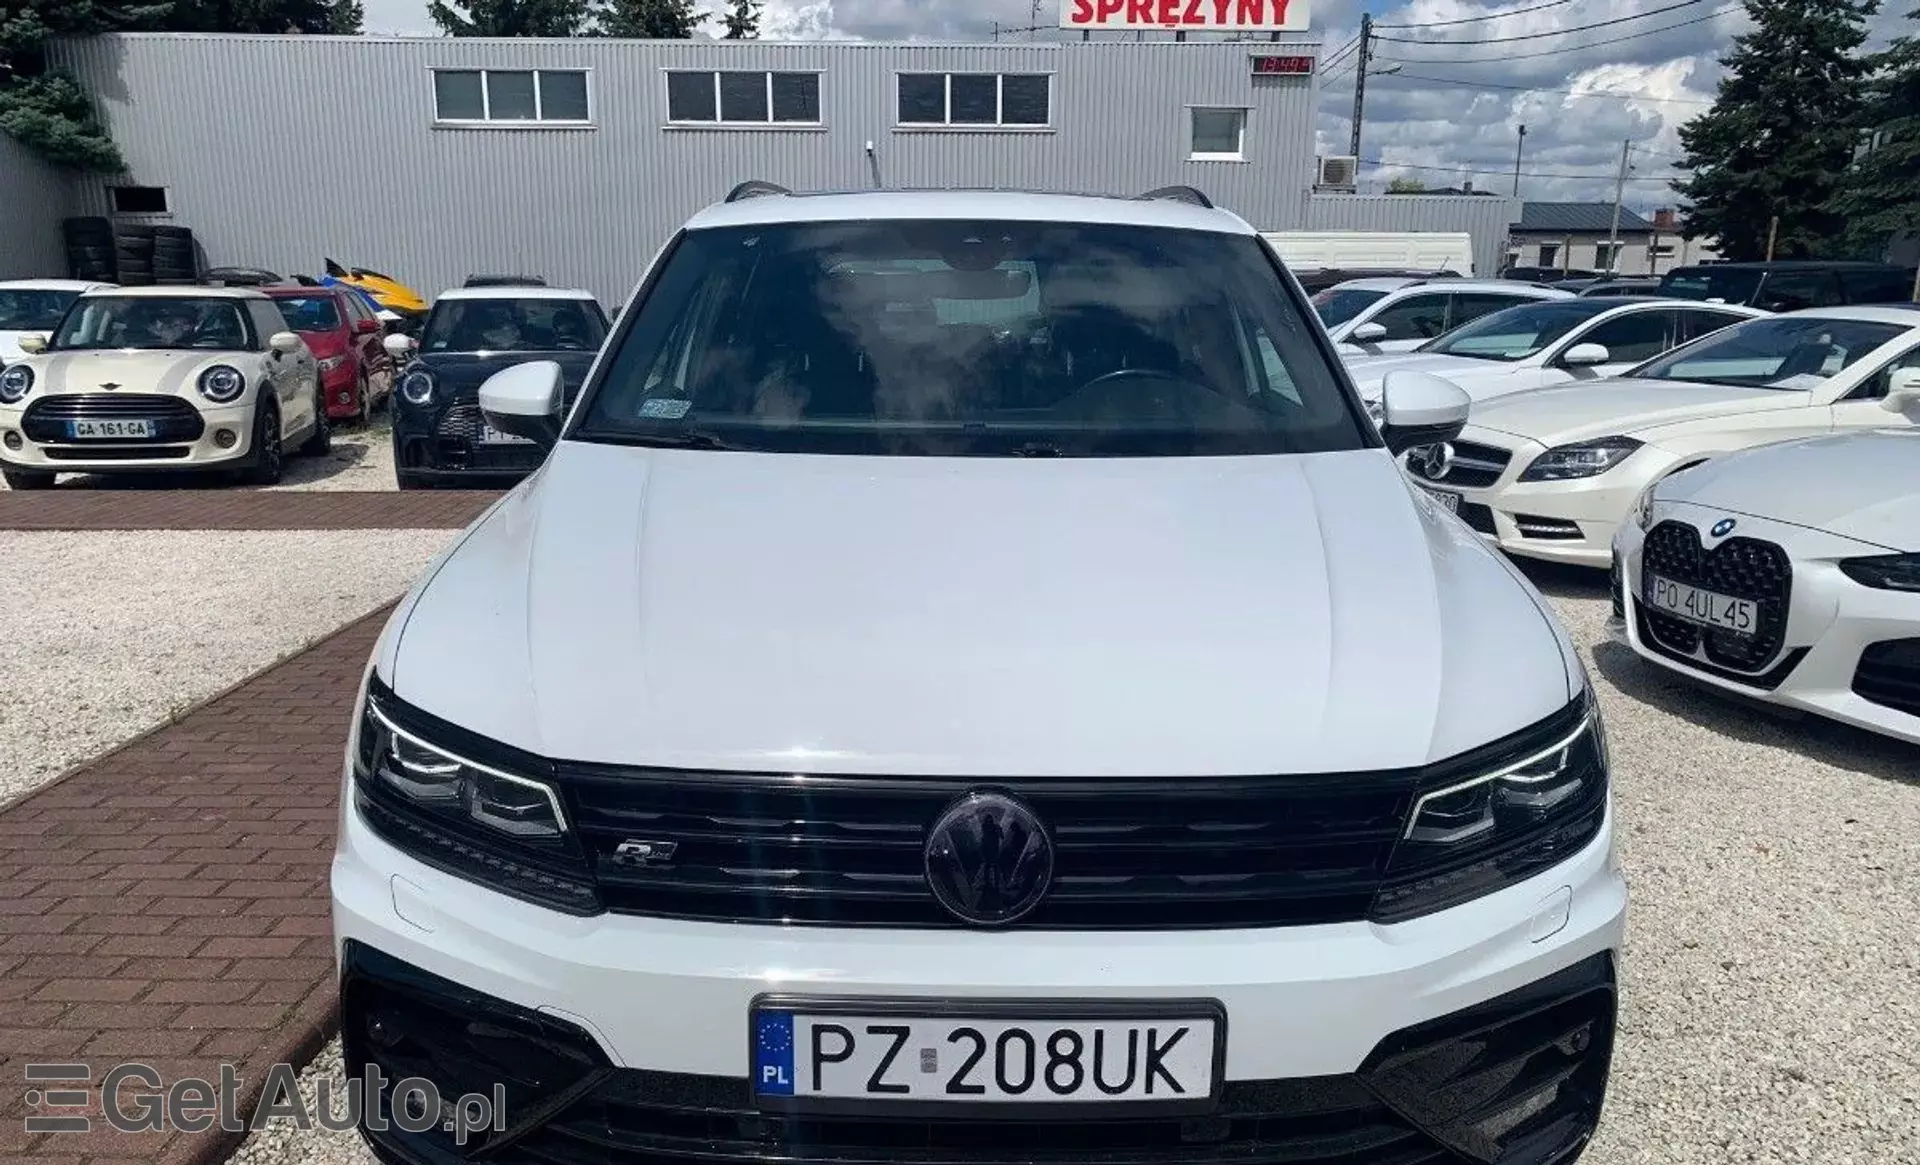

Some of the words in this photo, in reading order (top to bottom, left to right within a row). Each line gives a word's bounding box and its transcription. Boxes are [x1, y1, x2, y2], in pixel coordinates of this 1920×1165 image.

[1684, 590, 1750, 629] 4UL45
[763, 1065, 789, 1085] PL
[810, 1023, 911, 1094] PZ
[945, 1026, 1190, 1095] 208UK
